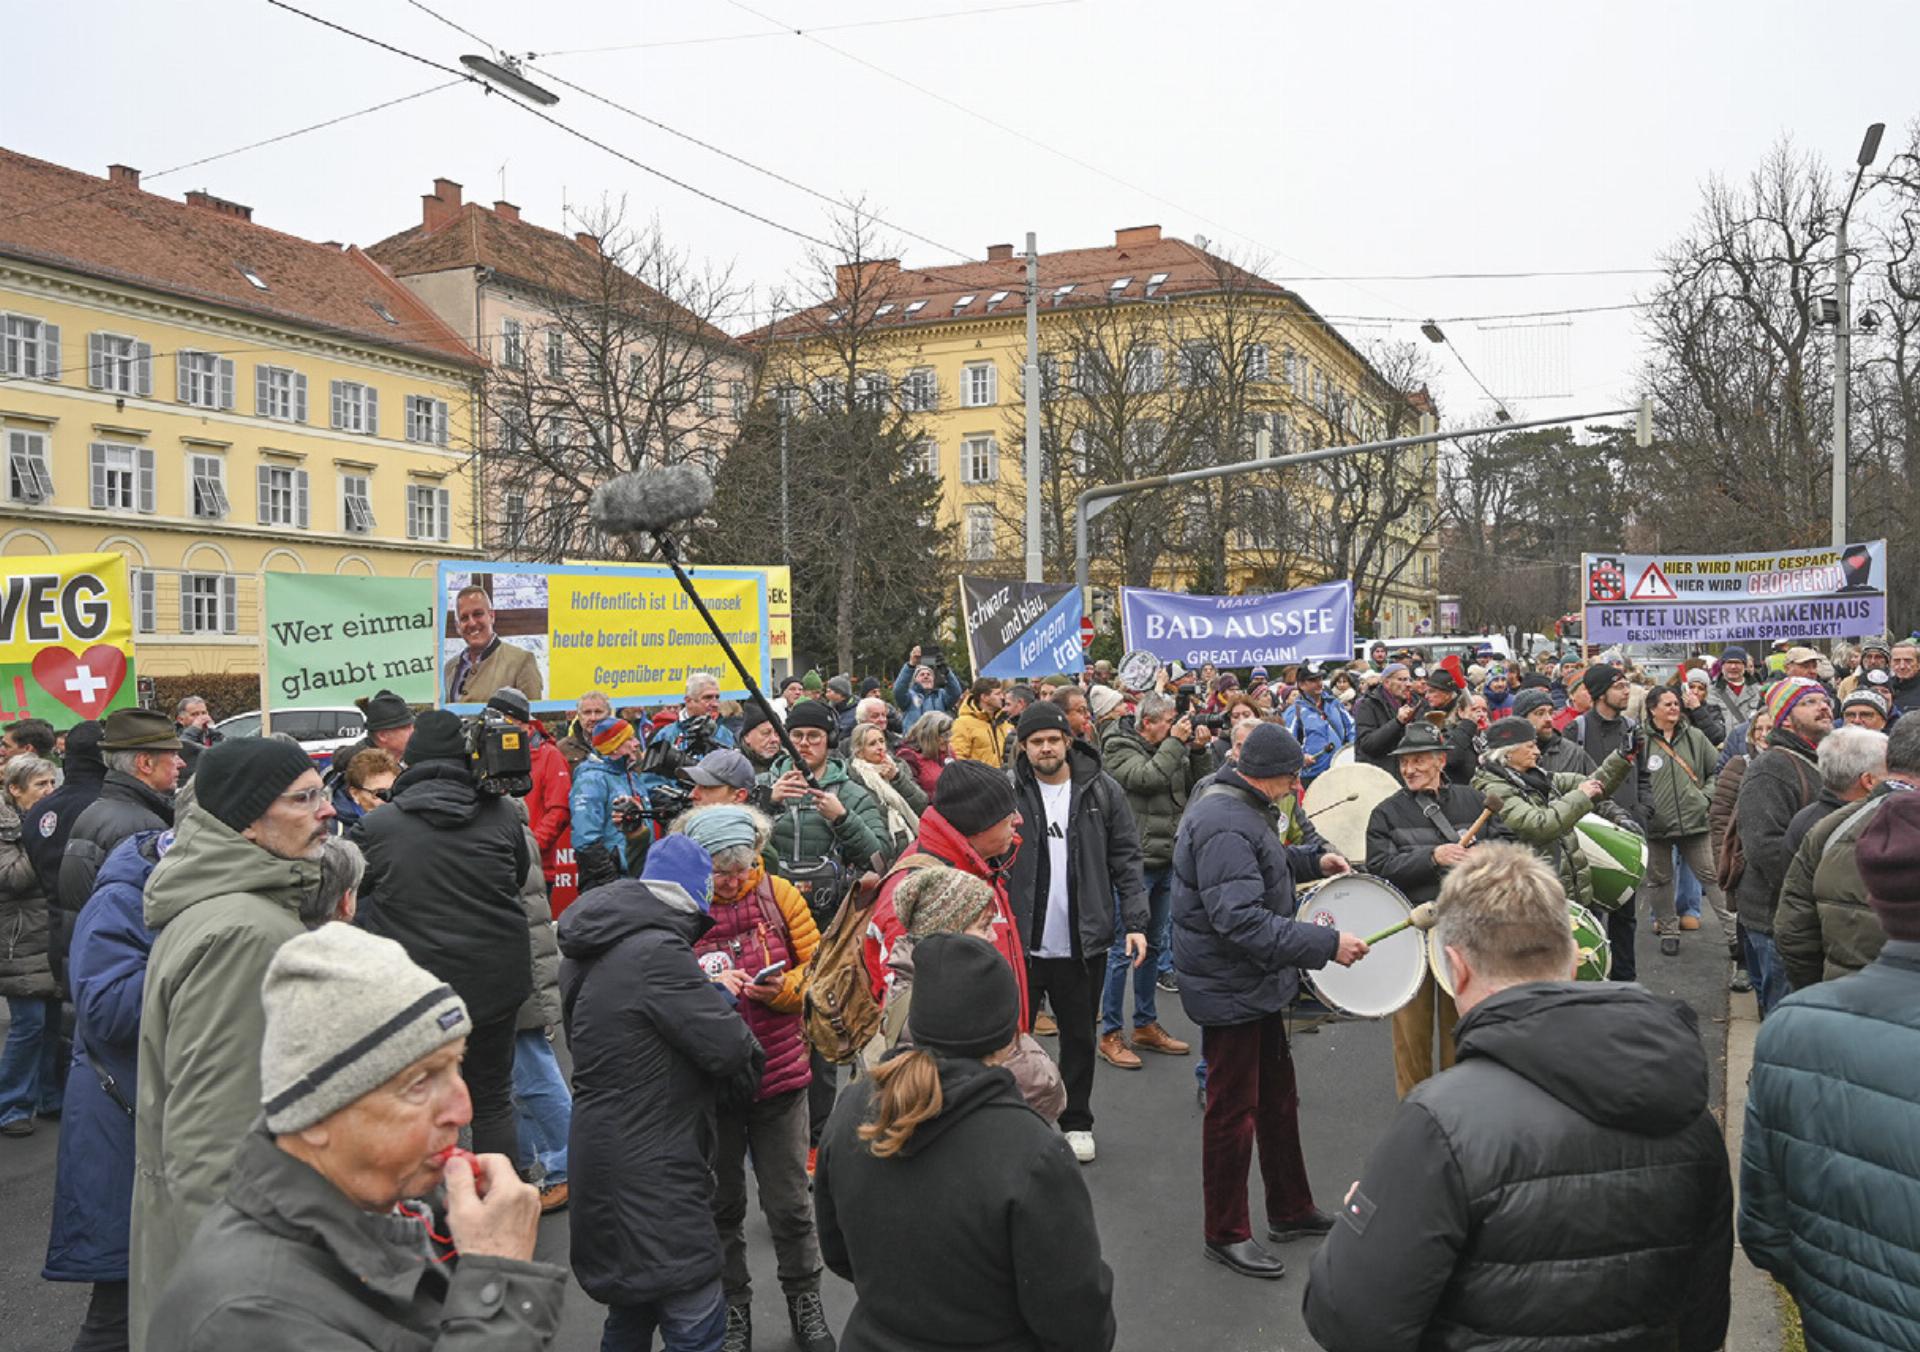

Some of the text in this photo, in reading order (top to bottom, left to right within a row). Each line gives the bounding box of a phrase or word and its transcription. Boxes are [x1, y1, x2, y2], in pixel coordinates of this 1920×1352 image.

[1663, 552, 1841, 574] HIER WIRD NICHT GESPART-
[1675, 566, 1844, 594] HIER WIRD GEOPFERT!
[571, 591, 647, 610] Hoffentlich
[649, 592, 666, 610] ist
[673, 592, 688, 610] LH
[1216, 598, 1261, 609] MAKE
[1601, 600, 1870, 627] RETTET UNSER KRANKENHAUS
[271, 607, 433, 646] Wer einmal
[1001, 595, 1048, 644] und blau,
[1146, 607, 1335, 639] BAD AUSSEE
[1627, 622, 1842, 641] GESUNDHEIT IST KEIN SPAROBJEKT!
[552, 628, 594, 648] heute
[597, 628, 638, 648] bereit
[641, 632, 665, 647] uns
[1020, 612, 1065, 670] keinem
[1186, 646, 1298, 664] GREAT AGAIN!
[281, 661, 376, 700] glaubt
[594, 664, 666, 689] Gegenüber
[668, 667, 683, 681] zu
